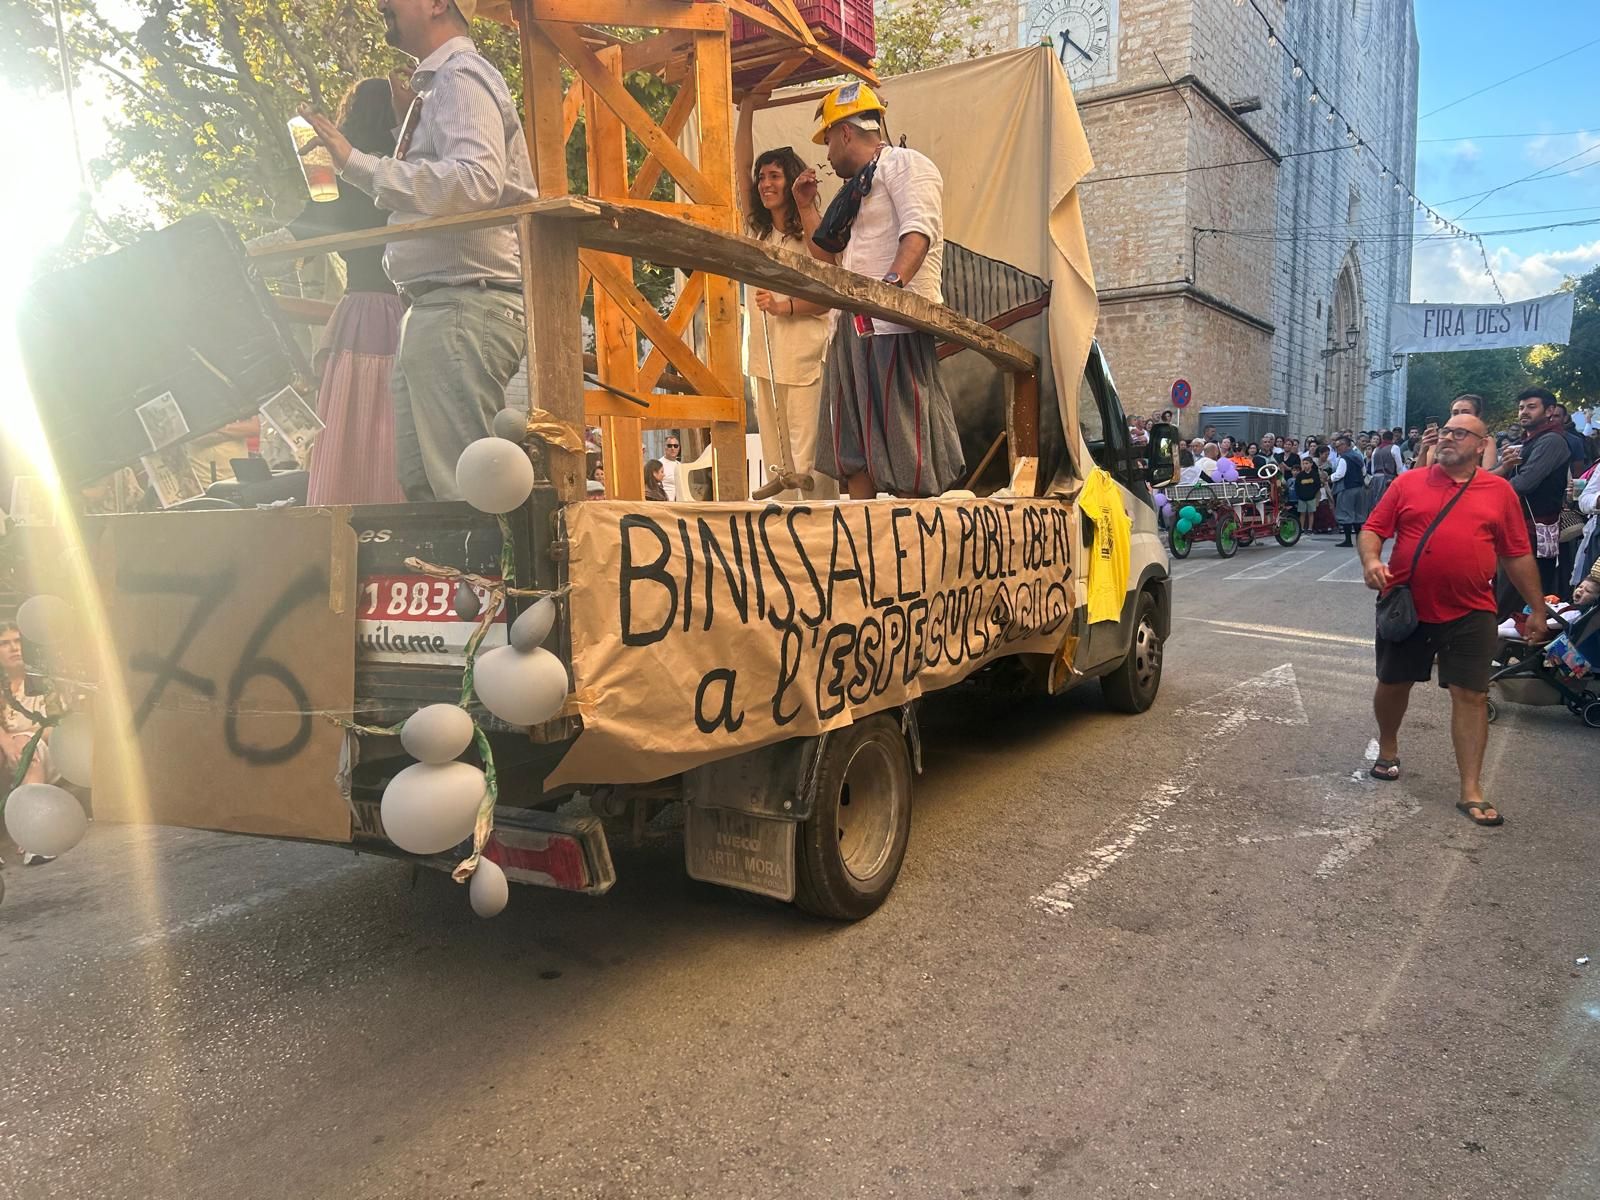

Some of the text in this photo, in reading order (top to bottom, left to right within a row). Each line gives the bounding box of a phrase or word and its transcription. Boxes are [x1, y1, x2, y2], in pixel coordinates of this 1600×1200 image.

[1423, 304, 1540, 338] FIRA DES VI
[619, 504, 948, 647] BINISSALEM
[957, 504, 1017, 580] POBLE
[1022, 506, 1071, 571] OBERT
[115, 560, 331, 768] 76
[693, 667, 744, 734] a
[744, 855, 783, 878] MORA
